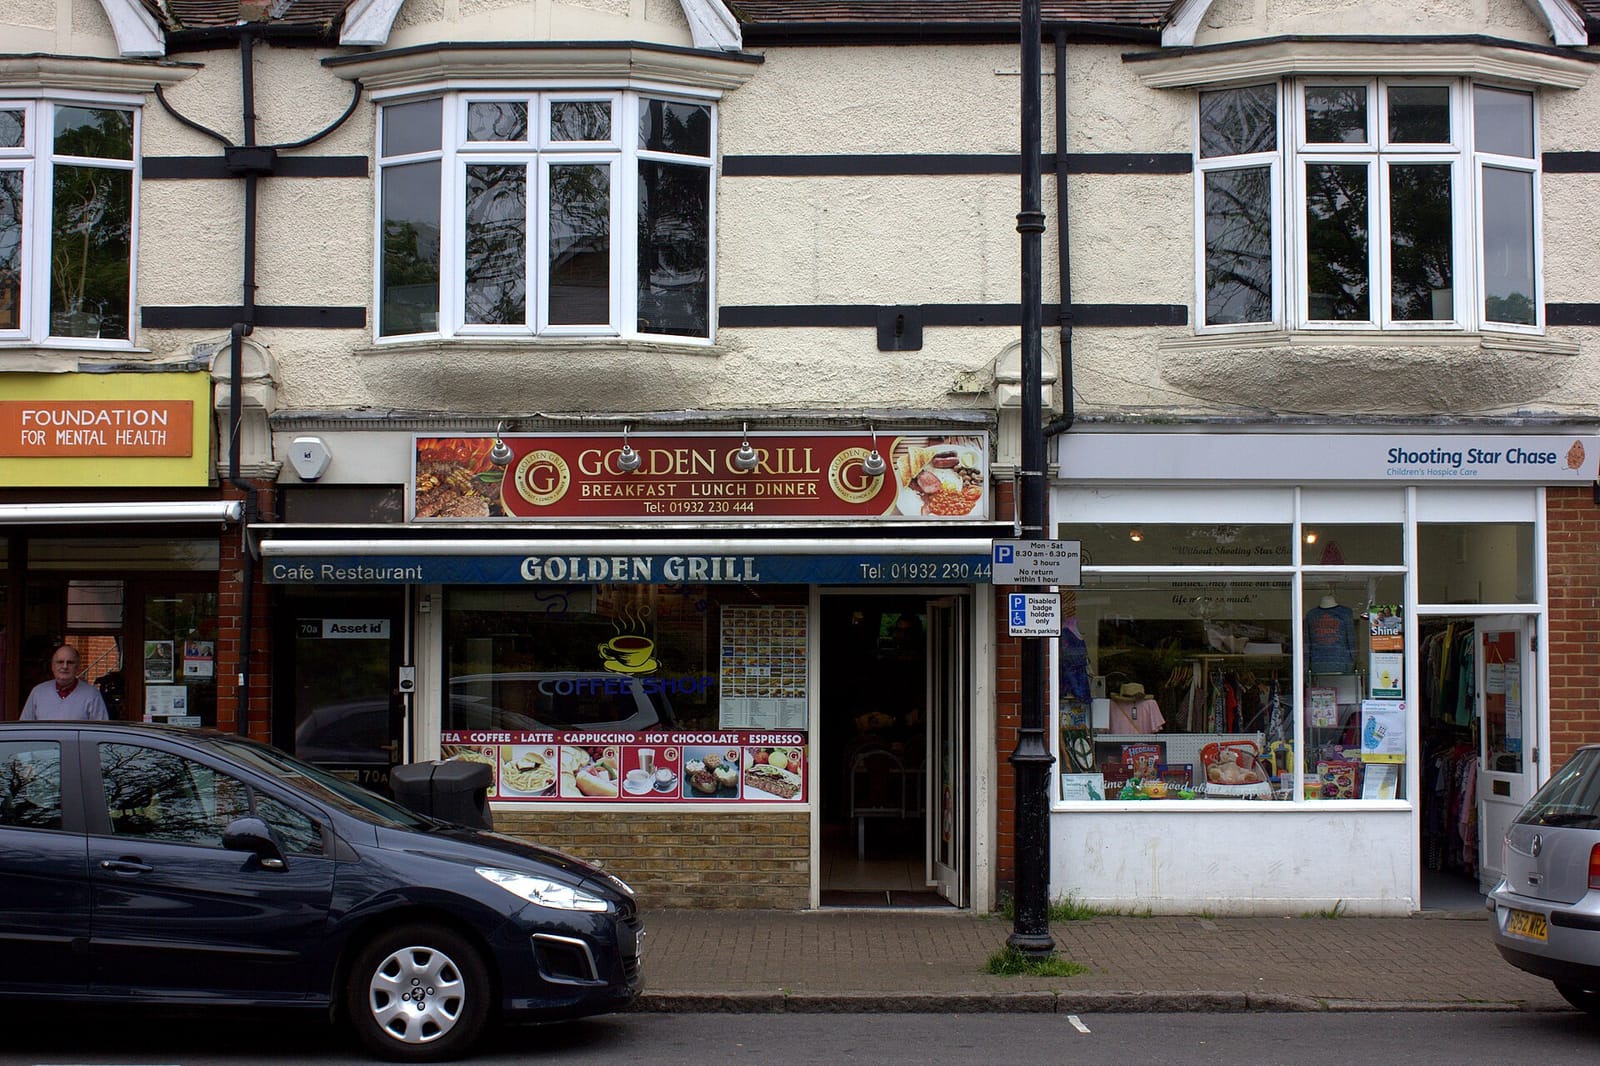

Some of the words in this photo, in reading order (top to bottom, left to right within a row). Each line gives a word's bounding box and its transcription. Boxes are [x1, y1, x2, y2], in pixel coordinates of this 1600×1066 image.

[21, 409, 168, 426] FOUNDATION
[21, 430, 46, 445] FOR
[56, 430, 107, 445] MENTAL
[116, 430, 167, 445] HEALTH
[578, 449, 717, 476] GOLDEN
[725, 447, 820, 475] GRILL
[1387, 448, 1463, 468] Shooting
[1467, 448, 1502, 464] Star
[1506, 448, 1557, 464] Chase
[529, 464, 554, 493] G
[1387, 468, 1424, 476] Children's
[1426, 468, 1458, 477] Hospice
[1459, 468, 1478, 476] Care
[582, 484, 677, 497] BREAKFAST
[691, 483, 746, 496] LUNCH
[755, 482, 817, 496] DINNER
[643, 501, 665, 513] Tel:
[669, 501, 704, 513] 01932
[708, 501, 730, 513] 230
[732, 501, 754, 513] 444
[272, 564, 314, 580] Cafe
[321, 564, 423, 580] Restaurant
[520, 556, 653, 582] GOLDEN
[663, 556, 760, 582] GRILL
[860, 563, 886, 579] Tel:
[891, 563, 937, 579] 01932
[942, 563, 969, 579] 230
[974, 563, 992, 579] 44
[330, 623, 367, 634] Asset
[370, 623, 382, 634] id
[1371, 626, 1399, 636] Shine
[537, 675, 634, 696] COFFEE
[643, 674, 715, 695] SHOP
[470, 732, 512, 743] COFFEE
[521, 732, 554, 743] LATTE
[563, 733, 636, 744] CAPPUCCINO
[645, 733, 669, 744] HOT
[671, 733, 739, 744] CHOCOLATE
[749, 734, 802, 744] ESPRESSO
[1104, 780, 1123, 790] ime
